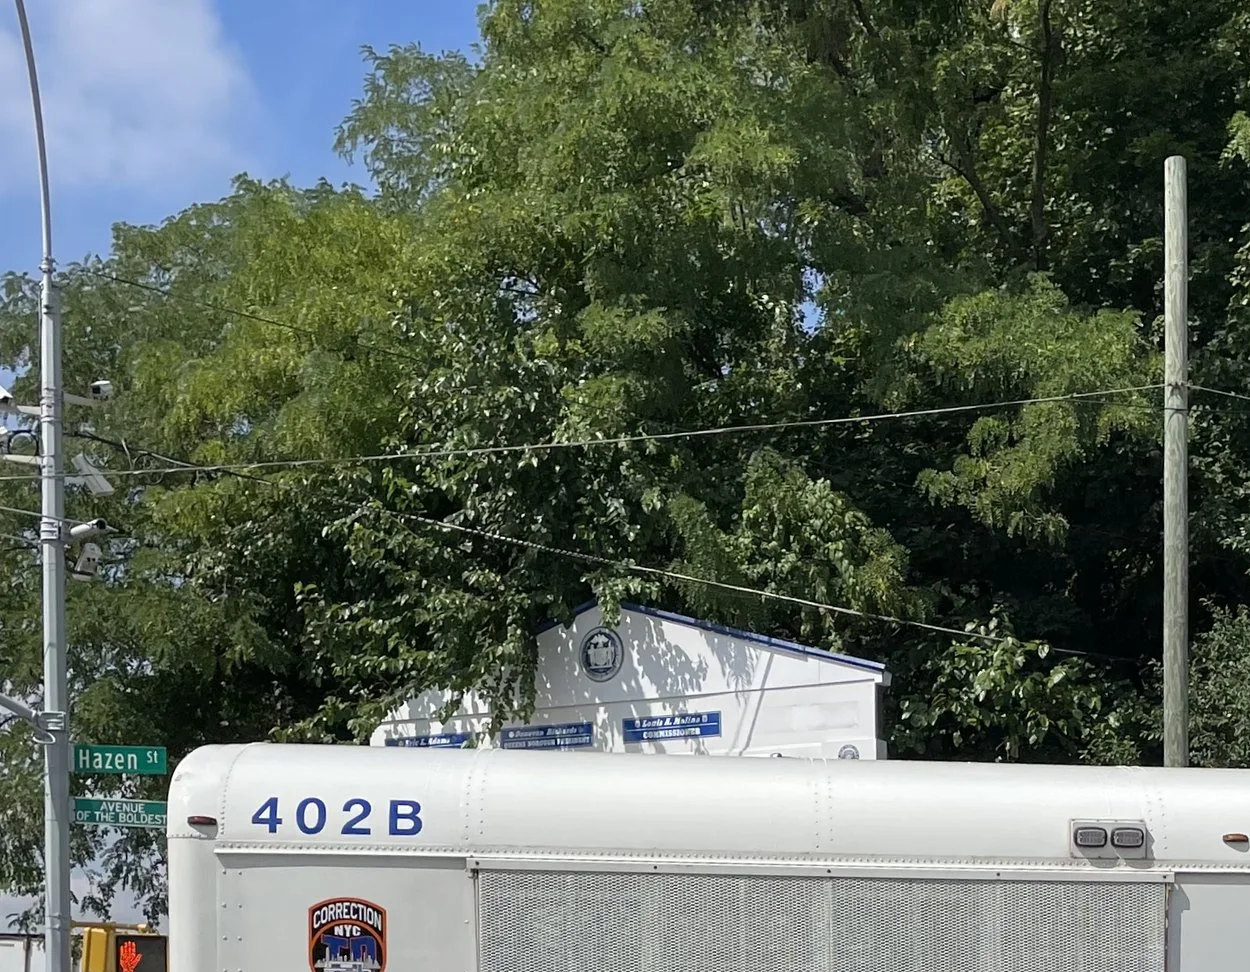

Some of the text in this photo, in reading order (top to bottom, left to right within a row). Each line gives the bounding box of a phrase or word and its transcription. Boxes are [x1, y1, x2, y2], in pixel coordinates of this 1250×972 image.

[642, 727, 701, 739] COMMISSIONER
[79, 748, 158, 770] Hazen St
[100, 801, 146, 813] AVENUE
[76, 810, 167, 825] OF THE BOLDEST
[251, 796, 423, 836] 402B
[313, 902, 382, 931] CORRECTION
[334, 924, 361, 937] NYC
